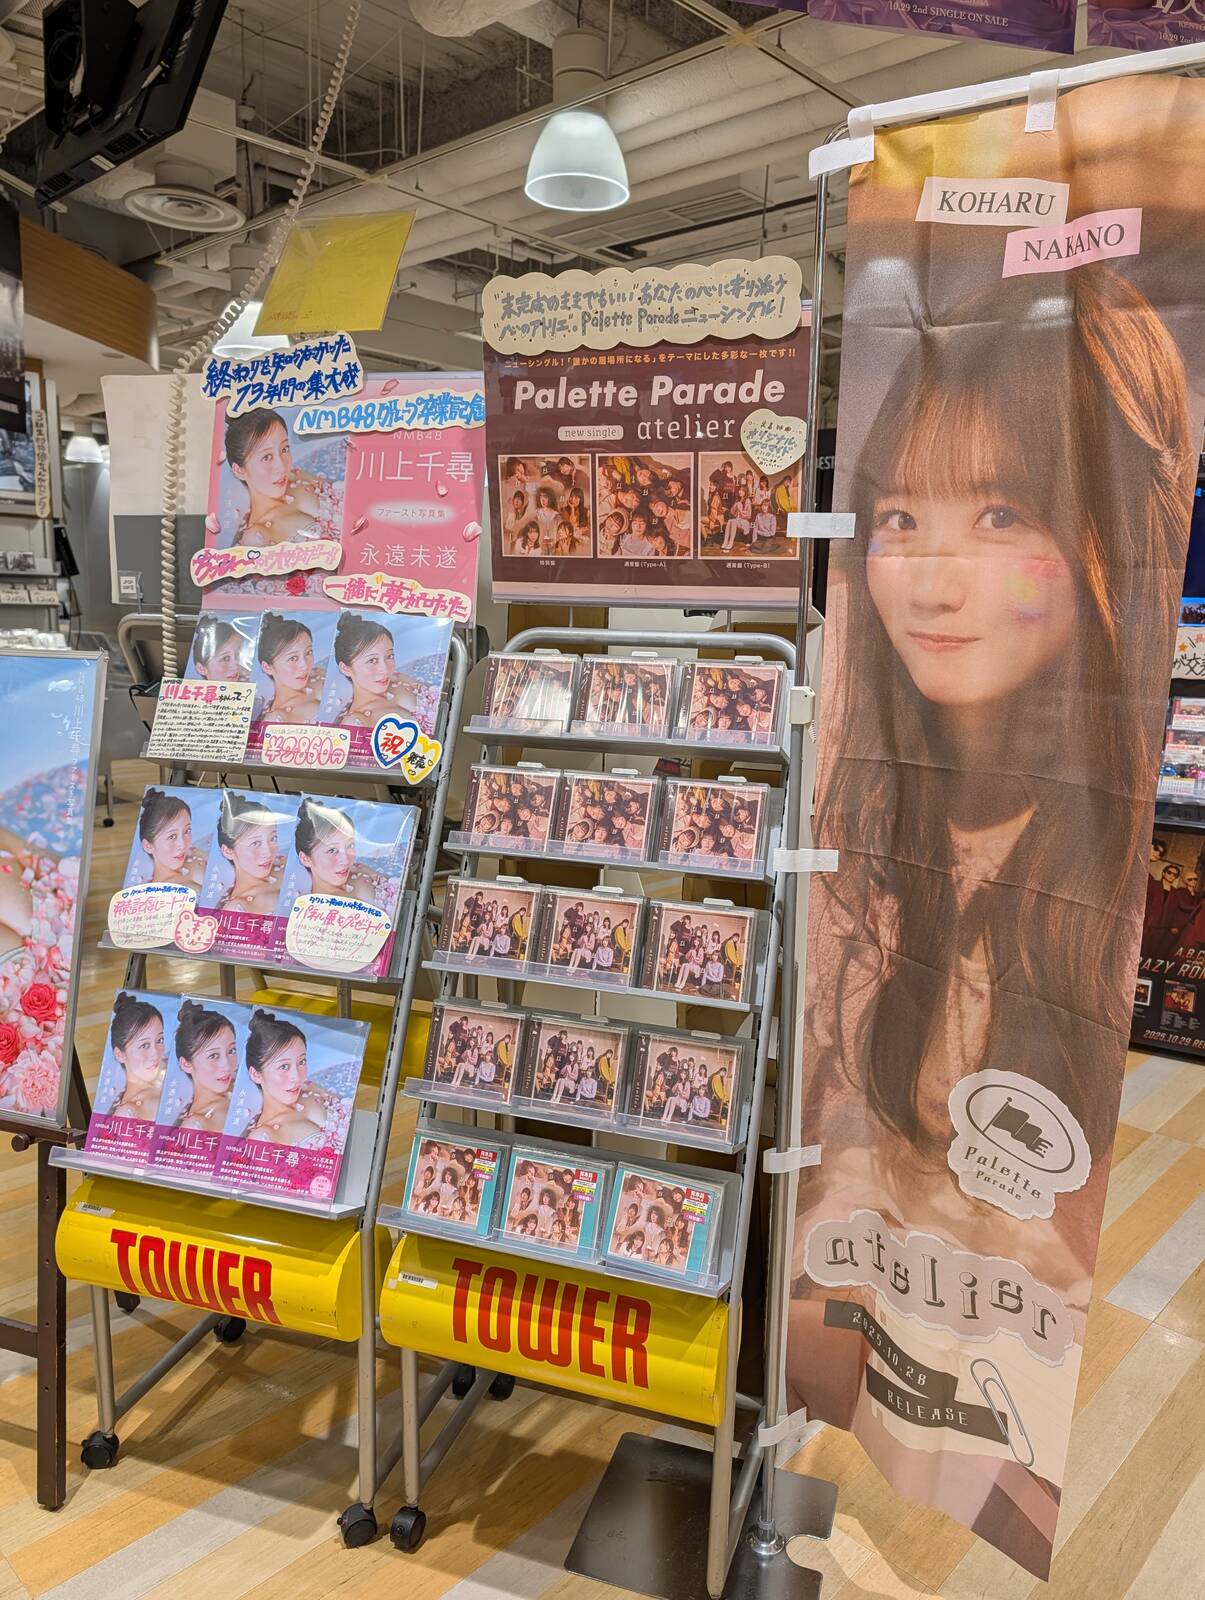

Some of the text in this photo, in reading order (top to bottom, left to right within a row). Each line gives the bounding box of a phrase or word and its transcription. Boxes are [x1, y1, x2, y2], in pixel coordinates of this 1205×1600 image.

[888, 1, 1009, 27] 10.29 2nd SINGLE ON SALE
[936, 189, 1056, 216] KOHARU
[1022, 222, 1126, 263] NAKANO
[513, 369, 785, 410] Palette Parade
[393, 431, 443, 441] NMB48
[564, 414, 736, 440] new single atelier
[355, 450, 475, 483] 川上千尋
[376, 507, 447, 519] ファースト写真集
[359, 543, 458, 569] 永遠未遂
[163, 684, 218, 705] 川上千尋
[380, 732, 405, 755] 祝
[406, 751, 426, 770] 発売
[218, 913, 273, 935] 川上千尋
[1138, 957, 1175, 975] AZY
[240, 1143, 300, 1168] 川上千尋
[964, 1145, 1043, 1200] Palette
[975, 1169, 1022, 1201] Parade
[110, 1228, 284, 1327] TOWER
[824, 1228, 1058, 1340] atelier
[451, 1257, 653, 1390] TOWER
[851, 1311, 928, 1387] 2025.10.28
[886, 1389, 969, 1426] RELEASE
